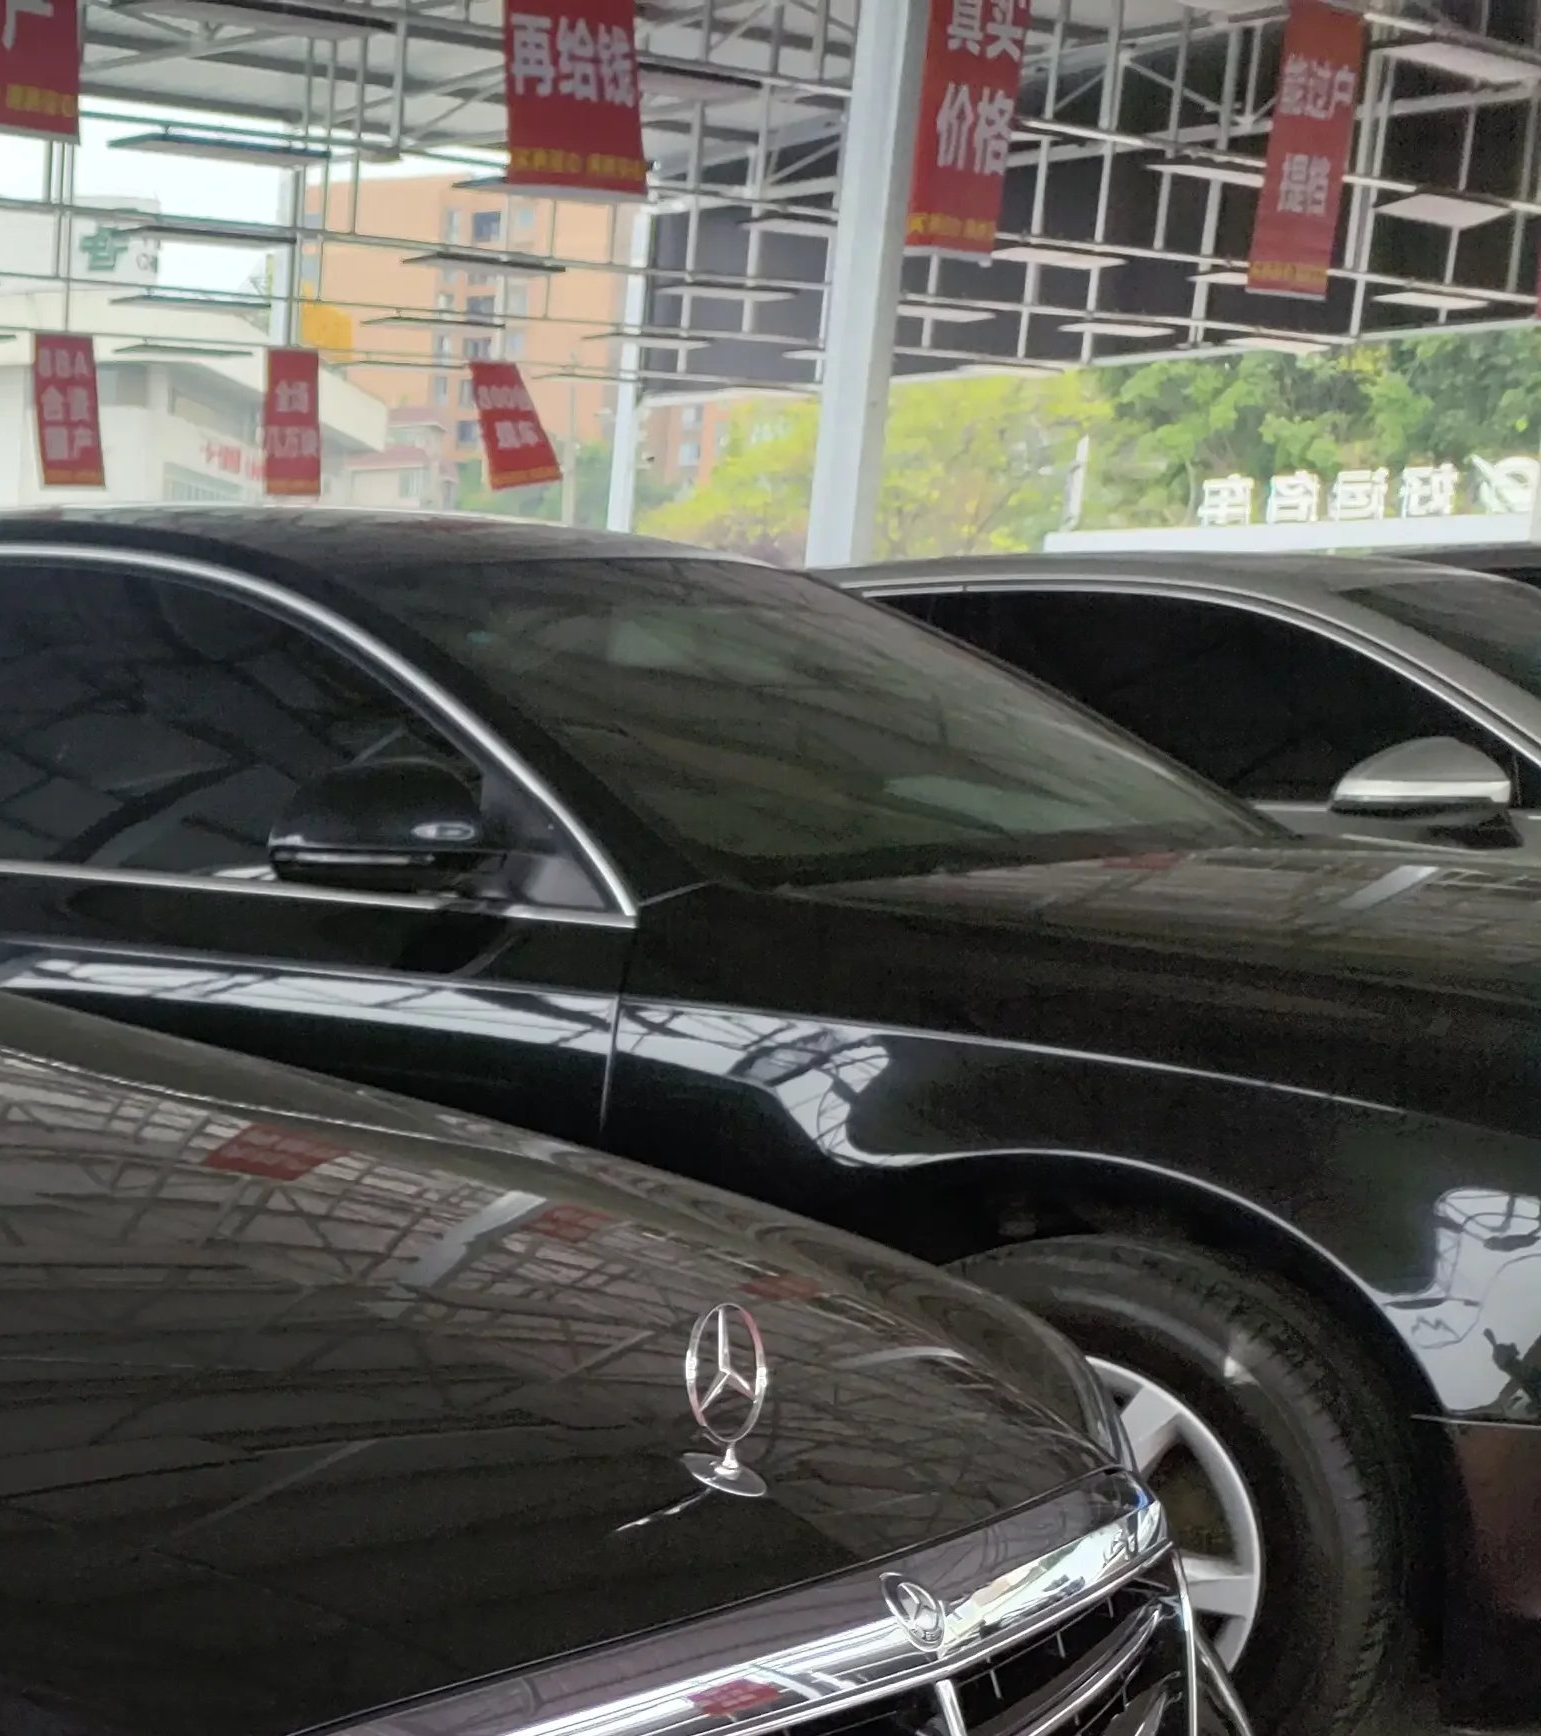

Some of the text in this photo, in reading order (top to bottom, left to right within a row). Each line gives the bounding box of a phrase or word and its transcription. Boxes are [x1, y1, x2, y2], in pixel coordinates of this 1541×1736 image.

[510, 12, 635, 109] 再给钱
[937, 81, 1015, 176] 价格
